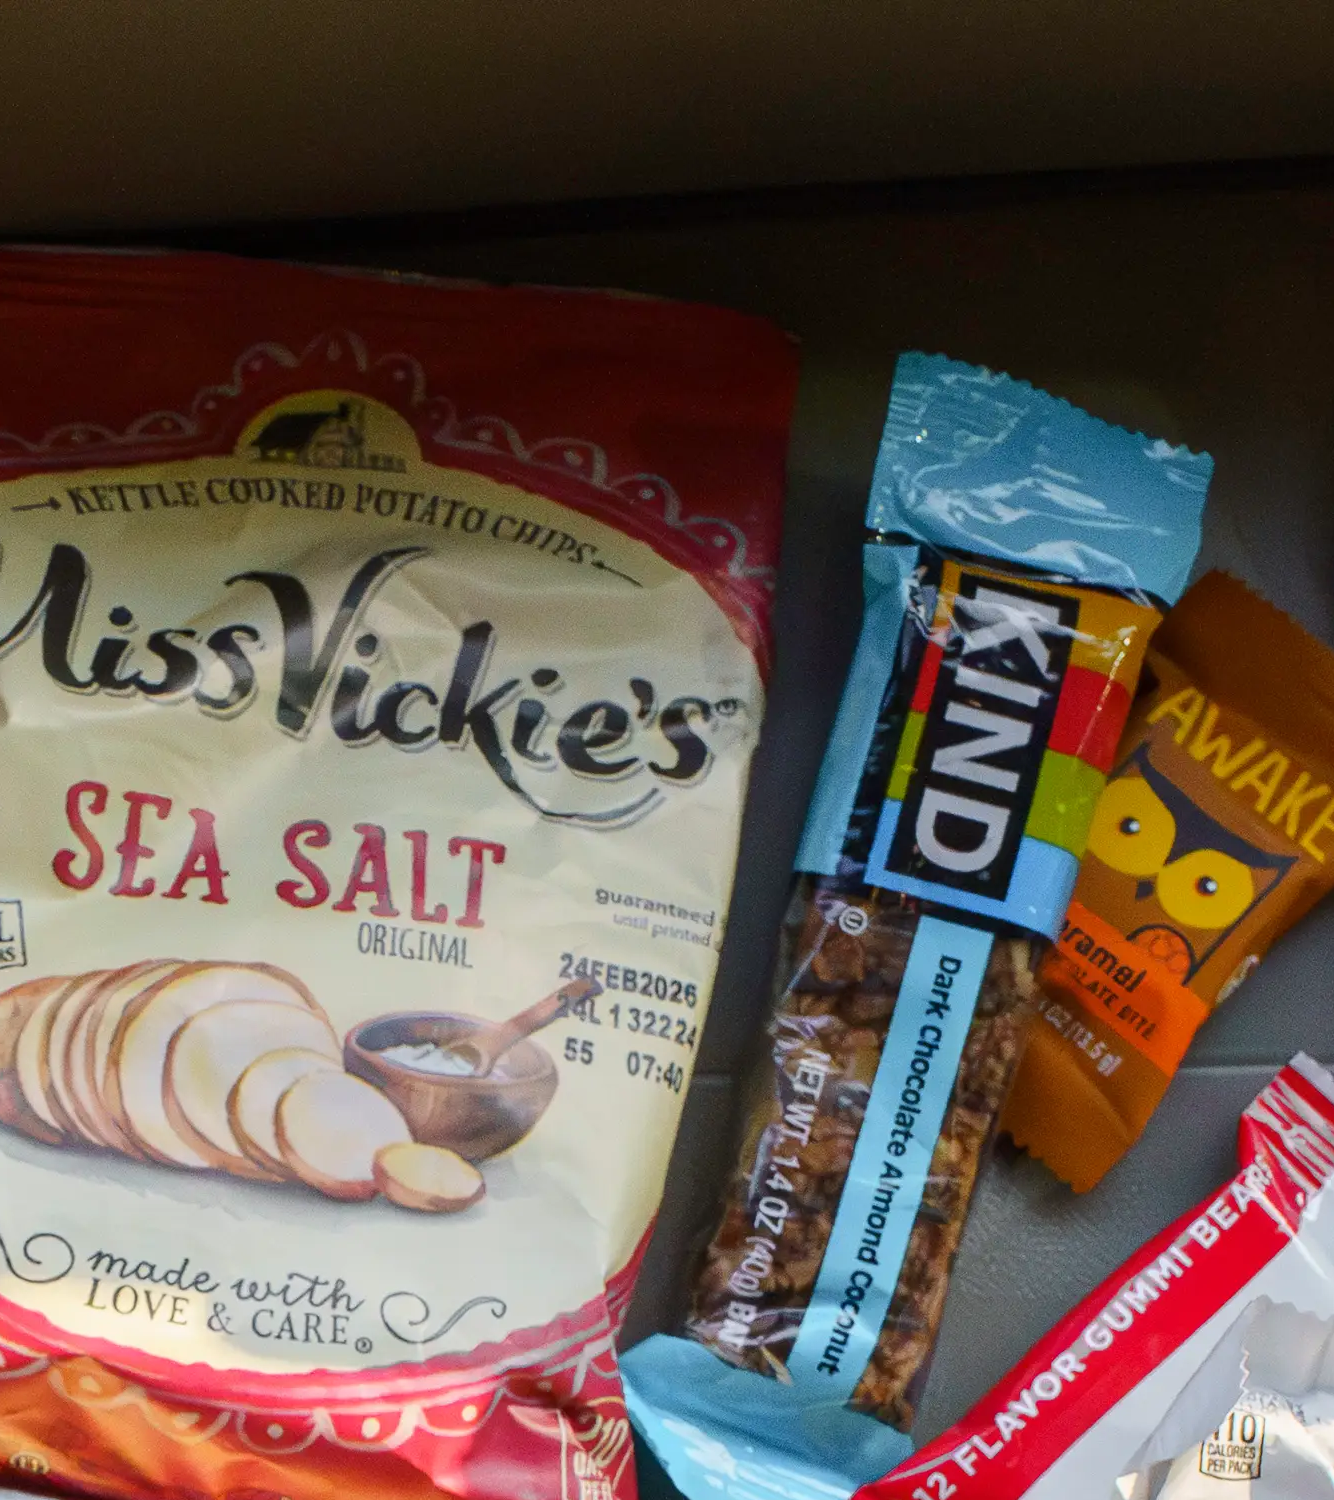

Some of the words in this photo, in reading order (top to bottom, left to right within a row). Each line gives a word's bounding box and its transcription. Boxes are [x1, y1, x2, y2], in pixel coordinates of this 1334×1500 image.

[67, 479, 197, 514] KETTLE
[205, 477, 346, 511] COOKED
[353, 481, 486, 535] POTATO
[492, 513, 600, 566] CHIPS
[222, 544, 715, 828] Vickie's
[913, 584, 1062, 875] KIND
[52, 780, 230, 905] SEA
[275, 817, 507, 929] SALT
[594, 887, 716, 927] guaranteed
[651, 922, 712, 947] printed
[357, 920, 476, 969] ORIGINAL
[558, 952, 698, 1009] 24FEB2026
[923, 955, 963, 1022] Dark
[626, 1050, 684, 1094] 07:40
[886, 1022, 945, 1158] Chocolate
[753, 1195, 791, 1236] OZ
[856, 1160, 906, 1267] Almond
[83, 1277, 189, 1328] LOVE
[206, 1302, 233, 1332] &
[84, 1242, 219, 1298] made
[230, 1269, 364, 1315] with
[816, 1268, 874, 1376] Coconut
[953, 1346, 1087, 1477] FLAVOR
[1083, 1245, 1193, 1354] GUMMI
[1205, 1457, 1228, 1475] PER
[1228, 1458, 1255, 1478] PACK
[1207, 1442, 1257, 1461] CALORIES
